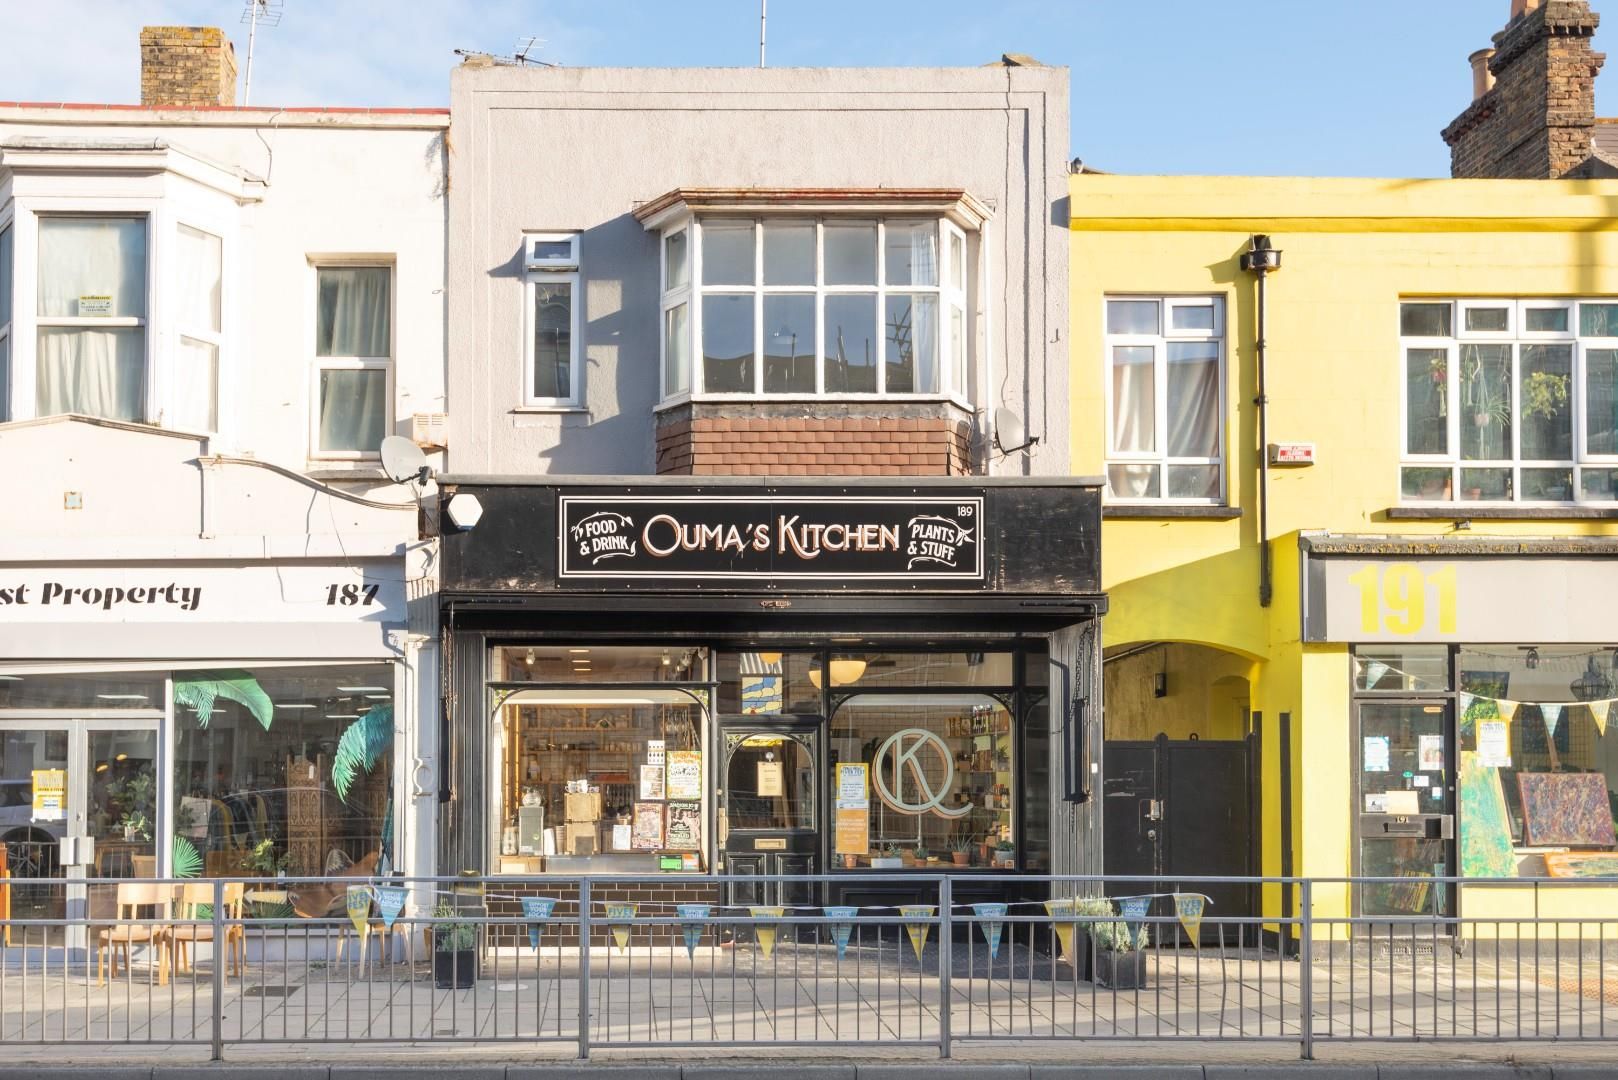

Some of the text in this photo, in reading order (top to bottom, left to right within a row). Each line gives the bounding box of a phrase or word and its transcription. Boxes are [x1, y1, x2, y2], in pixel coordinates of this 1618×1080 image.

[957, 506, 973, 517] 189
[585, 520, 617, 537] FOOD
[778, 515, 901, 559] KITCHEN
[911, 524, 955, 544] PLANTS
[580, 536, 629, 556] & DRINK
[907, 540, 956, 560] & STUFF
[41, 582, 201, 611] Property
[325, 583, 381, 606] 187
[1348, 563, 1457, 635] 191
